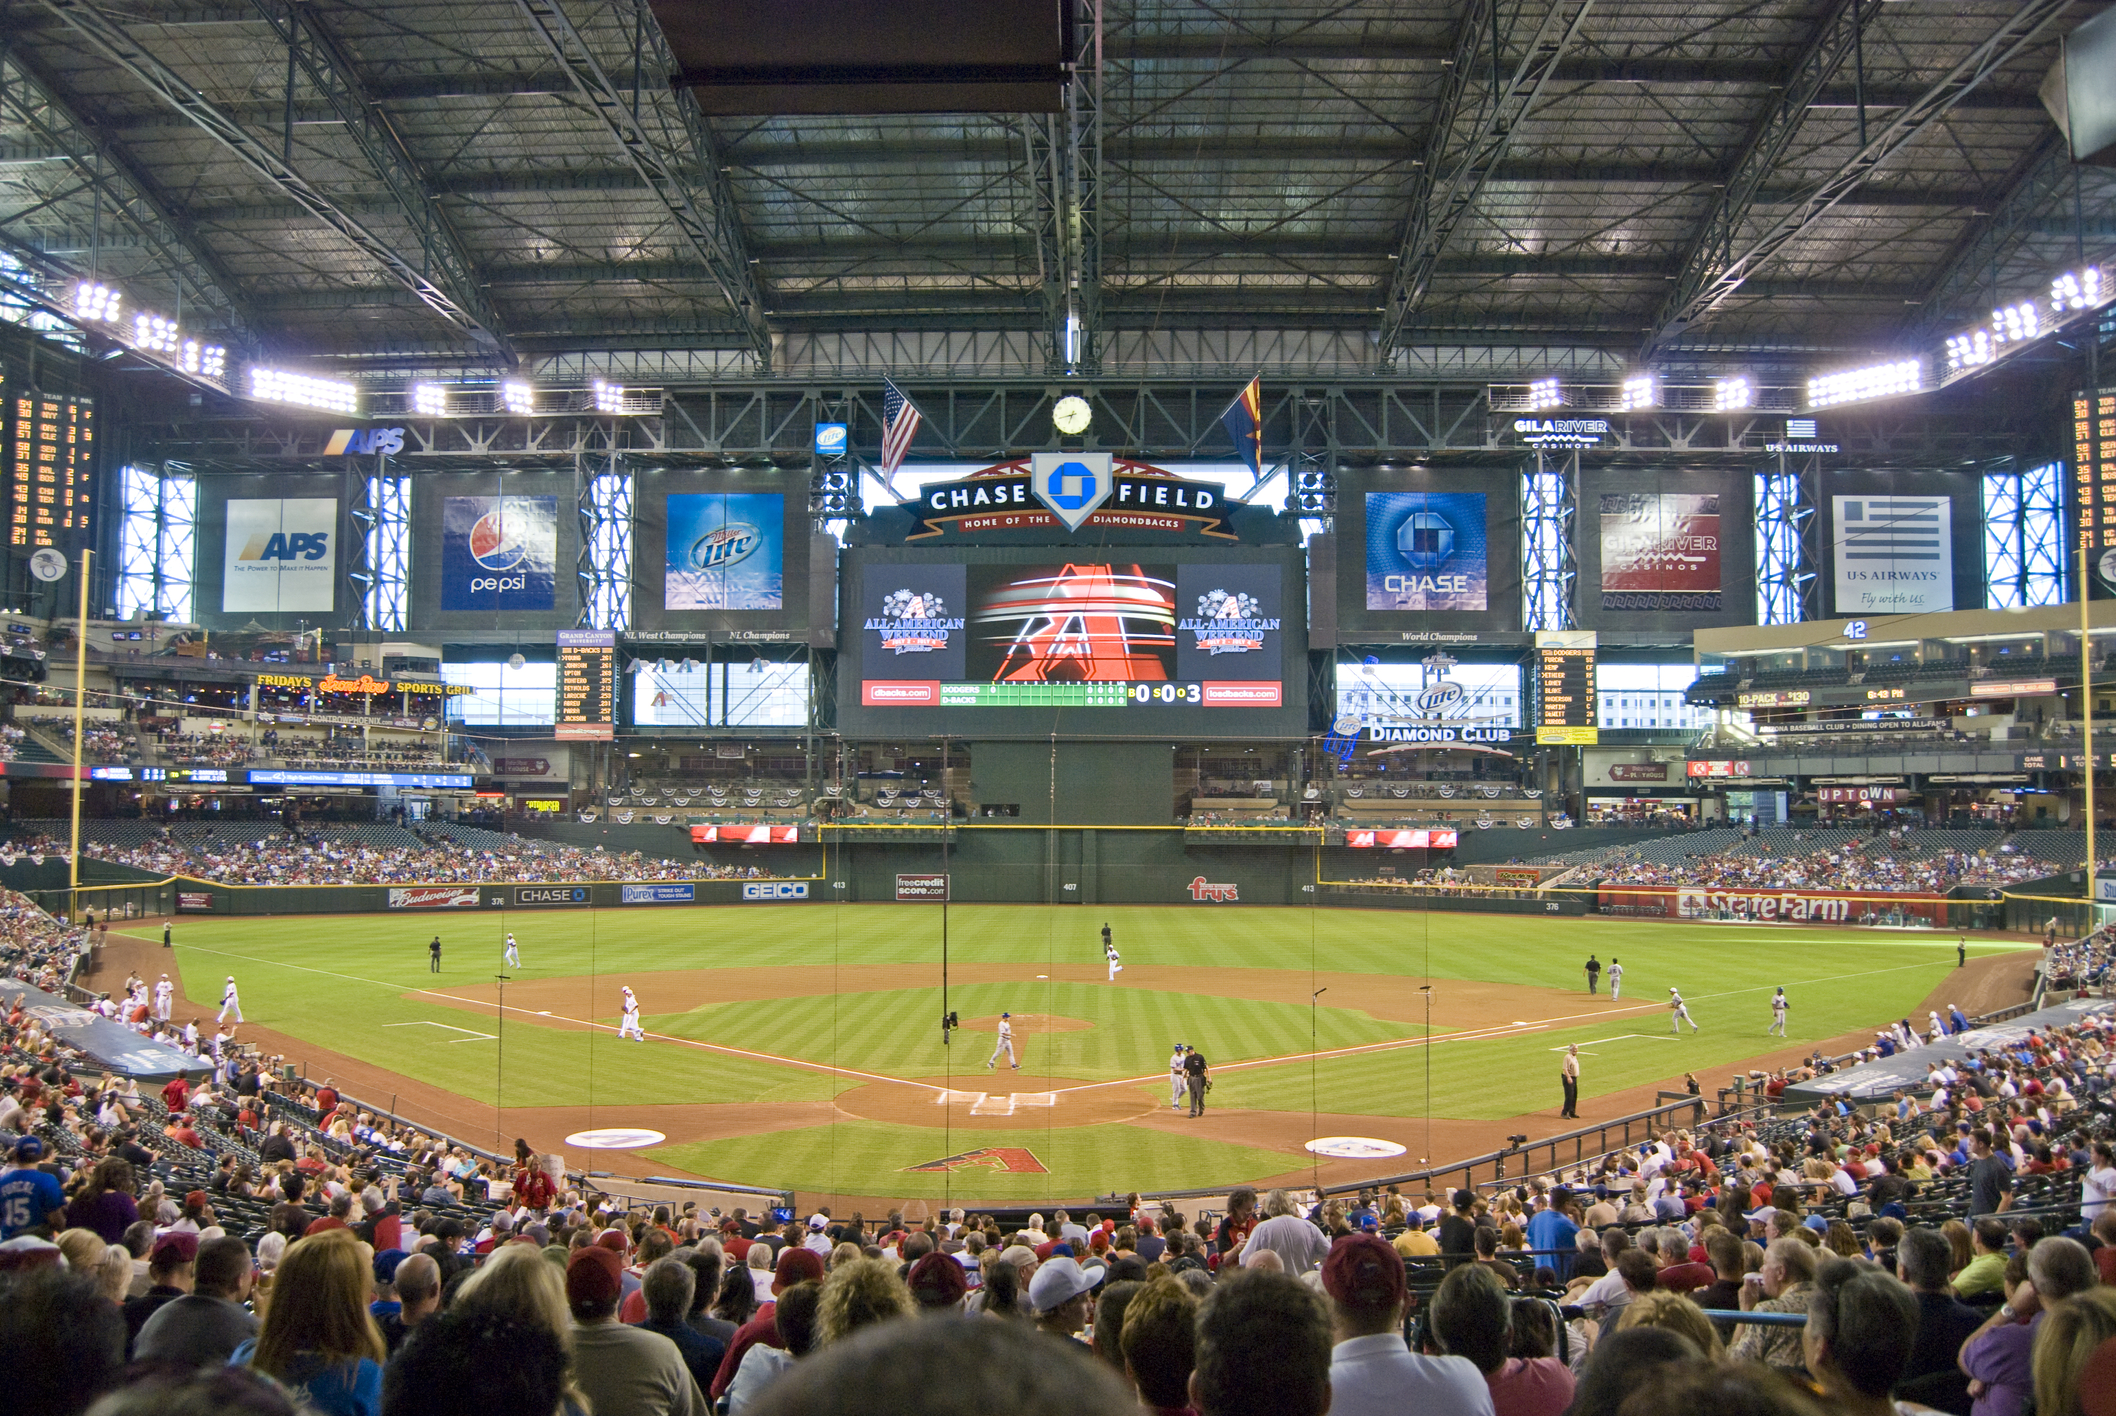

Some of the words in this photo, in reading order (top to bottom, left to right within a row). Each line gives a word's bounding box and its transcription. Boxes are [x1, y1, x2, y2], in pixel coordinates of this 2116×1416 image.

[44, 393, 63, 401] TEAM
[18, 399, 32, 409] 54
[43, 402, 58, 411] TOR
[2074, 400, 2089, 410] 54
[18, 408, 32, 418] 30
[41, 411, 58, 419] NYY
[2075, 409, 2089, 419] 30
[17, 421, 31, 430] 56
[41, 424, 57, 432] OAK
[1514, 420, 1554, 432] GILA
[1555, 420, 1607, 432] RIVER
[16, 430, 31, 439] 57
[41, 432, 57, 441] CLE
[342, 427, 405, 455] APS
[16, 441, 30, 451] 58
[40, 445, 56, 454] SEA
[1785, 444, 1838, 452] AIRWAYS
[16, 450, 30, 460] 37
[40, 453, 56, 461] DET
[39, 466, 55, 475] BAL
[38, 474, 55, 482] BOS
[38, 495, 54, 504] TEX
[930, 484, 1025, 510] CHASE
[1120, 484, 1214, 509] FIELD
[37, 508, 49, 516] TB
[13, 514, 27, 524] 30
[36, 516, 53, 525] MIN
[965, 517, 997, 528] HOME
[1006, 516, 1021, 525] OF
[1028, 516, 1050, 524] THE
[1093, 516, 1179, 528] DIAMONDBACKS
[13, 526, 26, 536] 34
[36, 529, 48, 537] KC
[709, 529, 742, 544] Miller
[12, 536, 26, 545] 51
[260, 532, 329, 561] APS
[1654, 536, 1717, 551] RIVER
[700, 536, 752, 569] Lite
[1871, 571, 1937, 580] AIRWAYS
[471, 574, 526, 593] pepsi
[1385, 576, 1469, 593] CHASE
[1861, 592, 1877, 609] Fly
[1879, 592, 1907, 604] with
[864, 618, 966, 630] ALL-AMERICAN
[1178, 618, 1281, 630] ALL-AMERICAN
[1843, 621, 1866, 639] 42
[624, 632, 637, 640] NL
[638, 632, 659, 640] West
[660, 632, 706, 641] Champions
[729, 632, 742, 640] NL
[743, 632, 790, 641] Champions
[880, 629, 950, 641] WEEKEND
[1194, 630, 1265, 641] WEEKEND
[1402, 633, 1428, 641] World
[1430, 632, 1478, 643] Champions
[257, 675, 312, 688] FRIDAY'S
[319, 673, 360, 692] Front
[360, 675, 390, 694] Row
[397, 682, 443, 694] SPORTS
[874, 689, 928, 697] dbacks.com
[942, 686, 980, 694] DODGERS
[990, 686, 996, 694] 0
[1128, 688, 1136, 698] B
[1136, 684, 1150, 703] 0
[1153, 688, 1162, 698] S
[1161, 684, 1176, 703] 0
[1187, 684, 1201, 703] 3
[1867, 690, 1889, 700] 6:43
[1892, 689, 1904, 698] PM
[1426, 690, 1457, 710] Lite
[1739, 693, 1778, 703] 10-PACK
[1788, 691, 1810, 701] $130
[307, 714, 393, 726] FRONTROWPHOENIX.com
[1759, 725, 1788, 733] ARIZONA
[1852, 722, 1878, 730] DINING
[1370, 726, 1455, 741] DIAMOND
[1461, 726, 1511, 742] CLUB
[1820, 787, 1893, 800] UPTOWN
[832, 882, 846, 890] 413
[898, 878, 944, 887] freecredit
[626, 886, 654, 900] Purex
[744, 882, 808, 898] GEICO
[898, 887, 944, 895] score.com
[1187, 876, 1238, 902] fry's
[1302, 885, 1315, 893] 413
[400, 887, 464, 906] Budweiser
[492, 897, 505, 906] 376
[522, 890, 570, 902] CHASE
[1546, 903, 1559, 911] 376
[1711, 892, 1775, 917] State
[1779, 893, 1849, 920] Farm
[6, 1197, 31, 1227] 15
